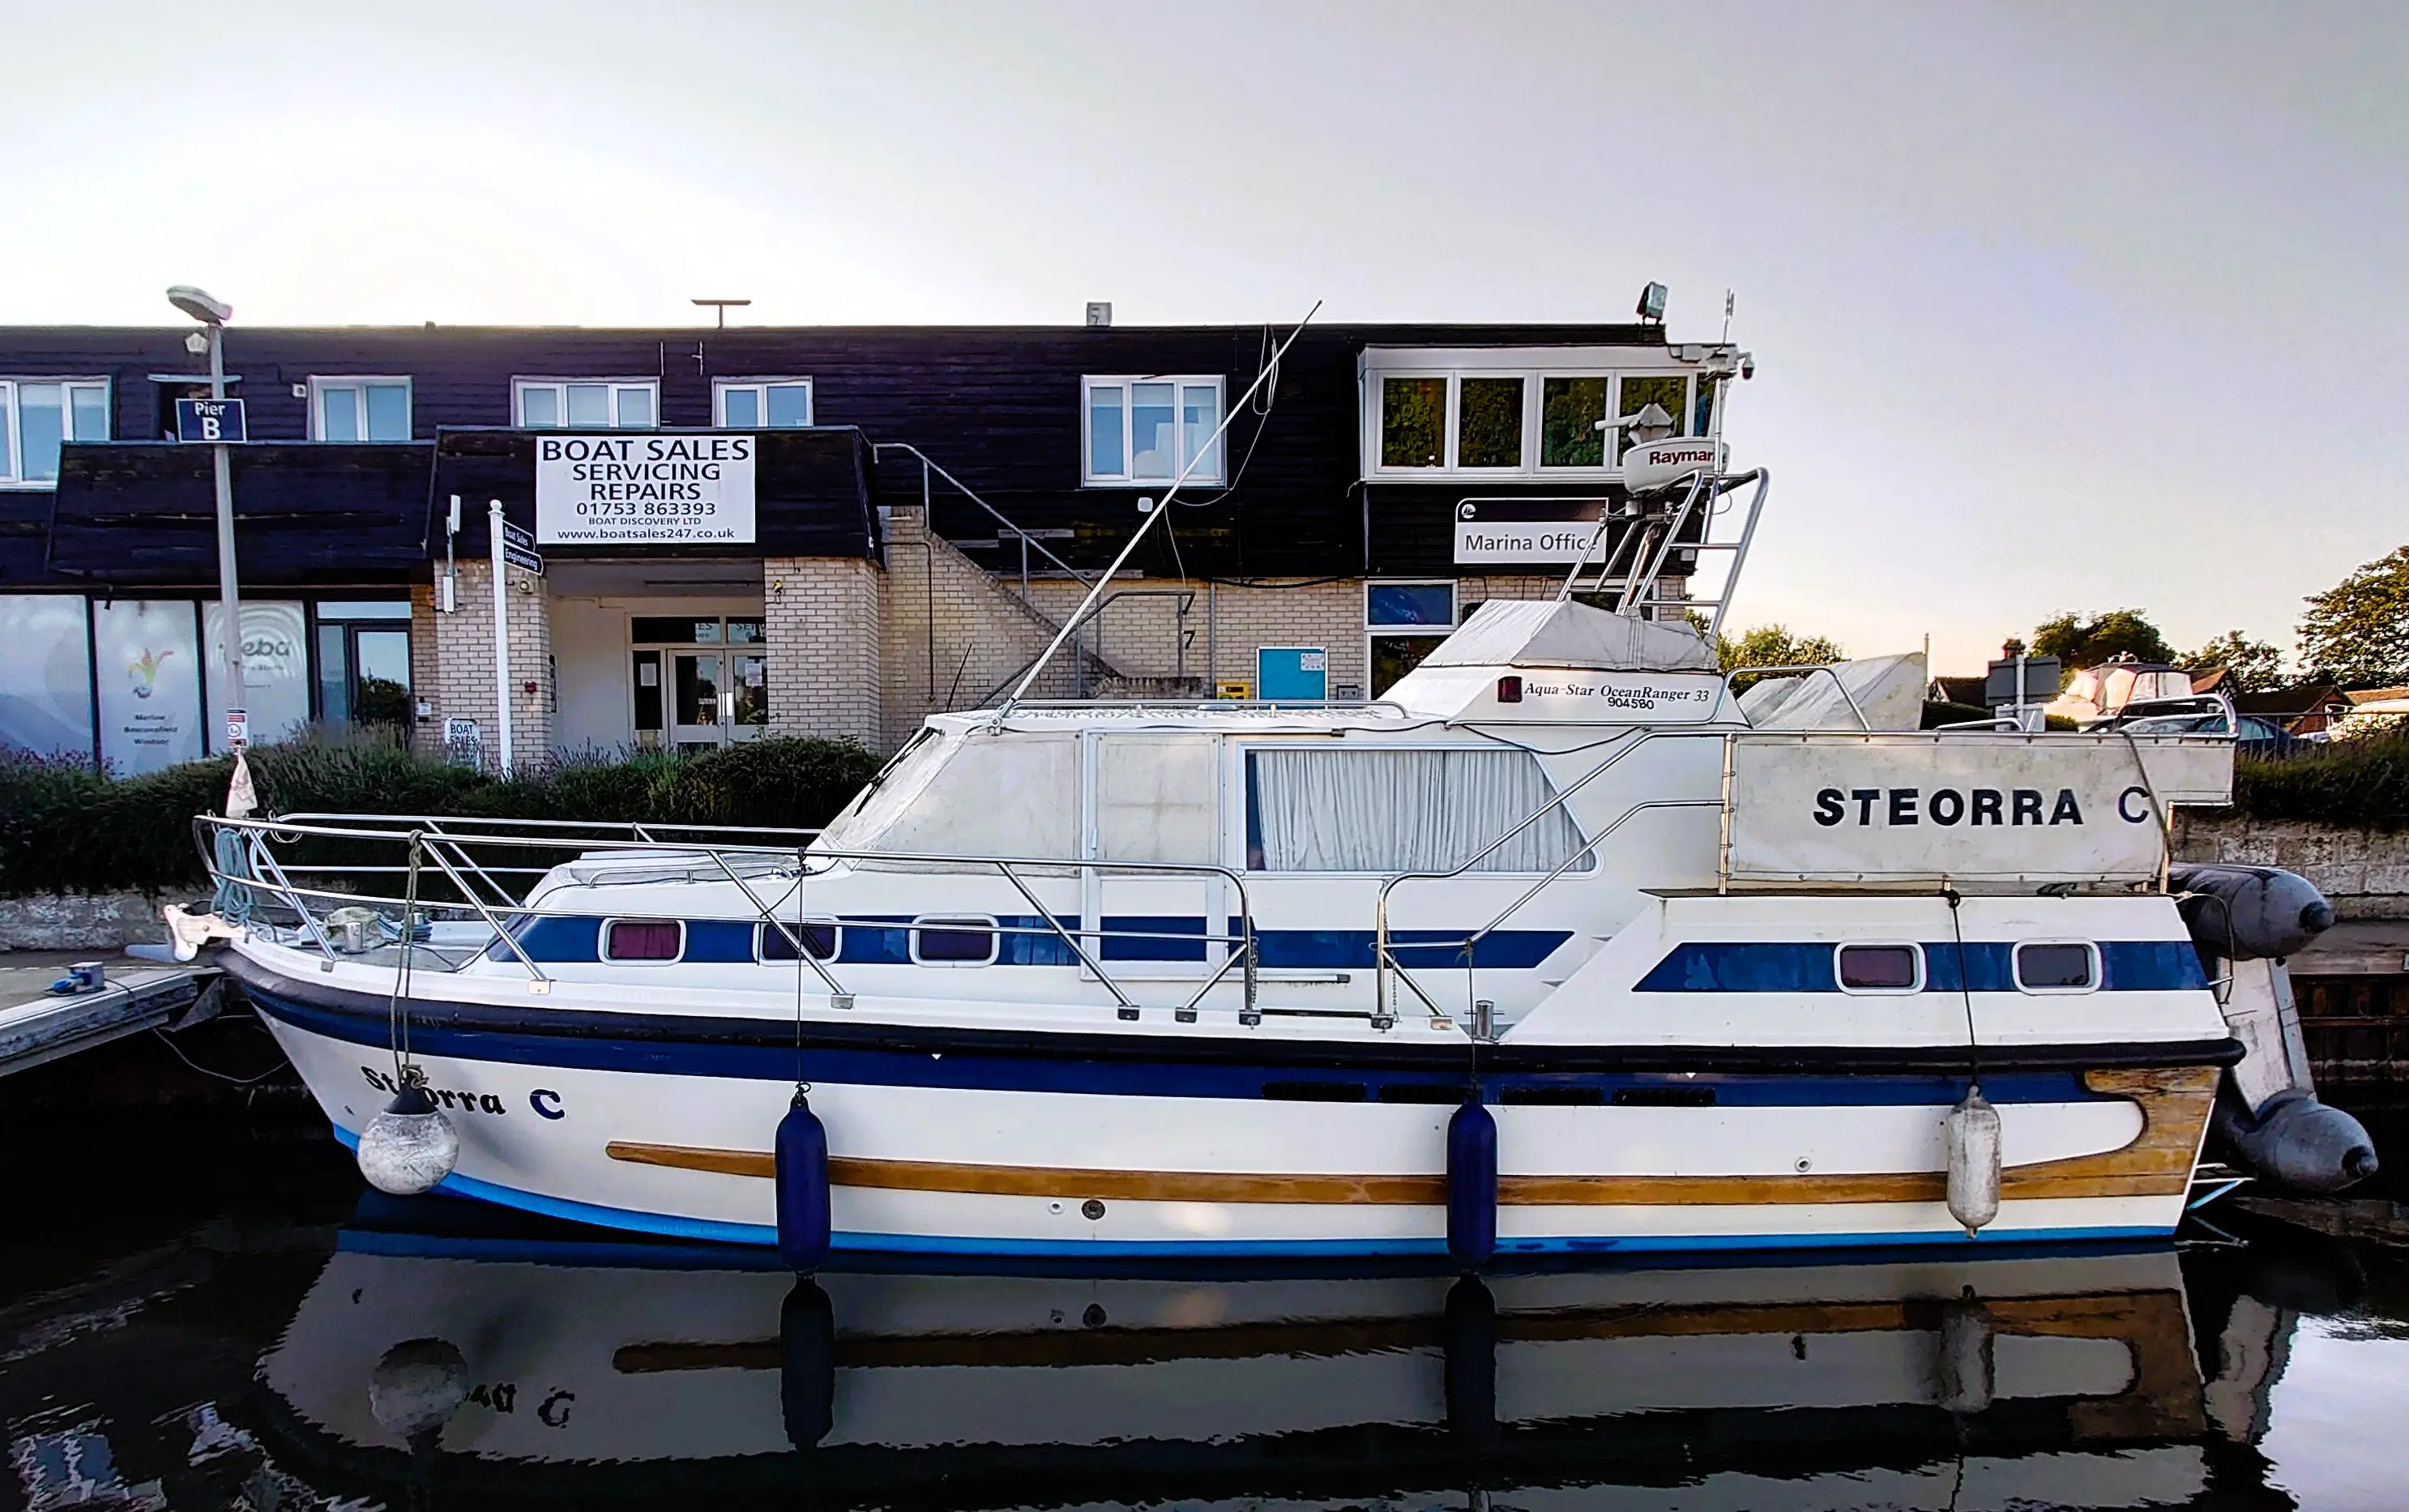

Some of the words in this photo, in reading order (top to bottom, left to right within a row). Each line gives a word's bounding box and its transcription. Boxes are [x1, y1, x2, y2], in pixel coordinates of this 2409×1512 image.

[194, 401, 226, 416] Pier
[202, 416, 221, 440] B
[542, 439, 634, 461] BOAT
[647, 439, 750, 461] SALES
[572, 463, 720, 481] SERVICING
[591, 483, 701, 501] REPAIRS
[576, 502, 637, 515] 01753
[643, 502, 716, 515] 863393
[588, 517, 617, 525] BOAT
[620, 517, 680, 525] DISCOVERY
[683, 517, 702, 525] LTD
[505, 527, 516, 541] Boat
[516, 532, 528, 546] Sales
[557, 528, 735, 540] www.boatsales247.co.uk
[1465, 534, 1532, 551] Marina
[505, 548, 538, 570] Engineering
[1524, 683, 1594, 696] Aqua-Star
[1600, 685, 1691, 700] OceanRanger
[1694, 690, 1710, 702] 33
[1608, 698, 1655, 710] 904580
[451, 724, 473, 734] BOAT
[1813, 788, 2084, 826] STEORRA
[2118, 786, 2151, 823] C
[361, 1066, 506, 1115] Storra
[530, 1088, 566, 1120] C
